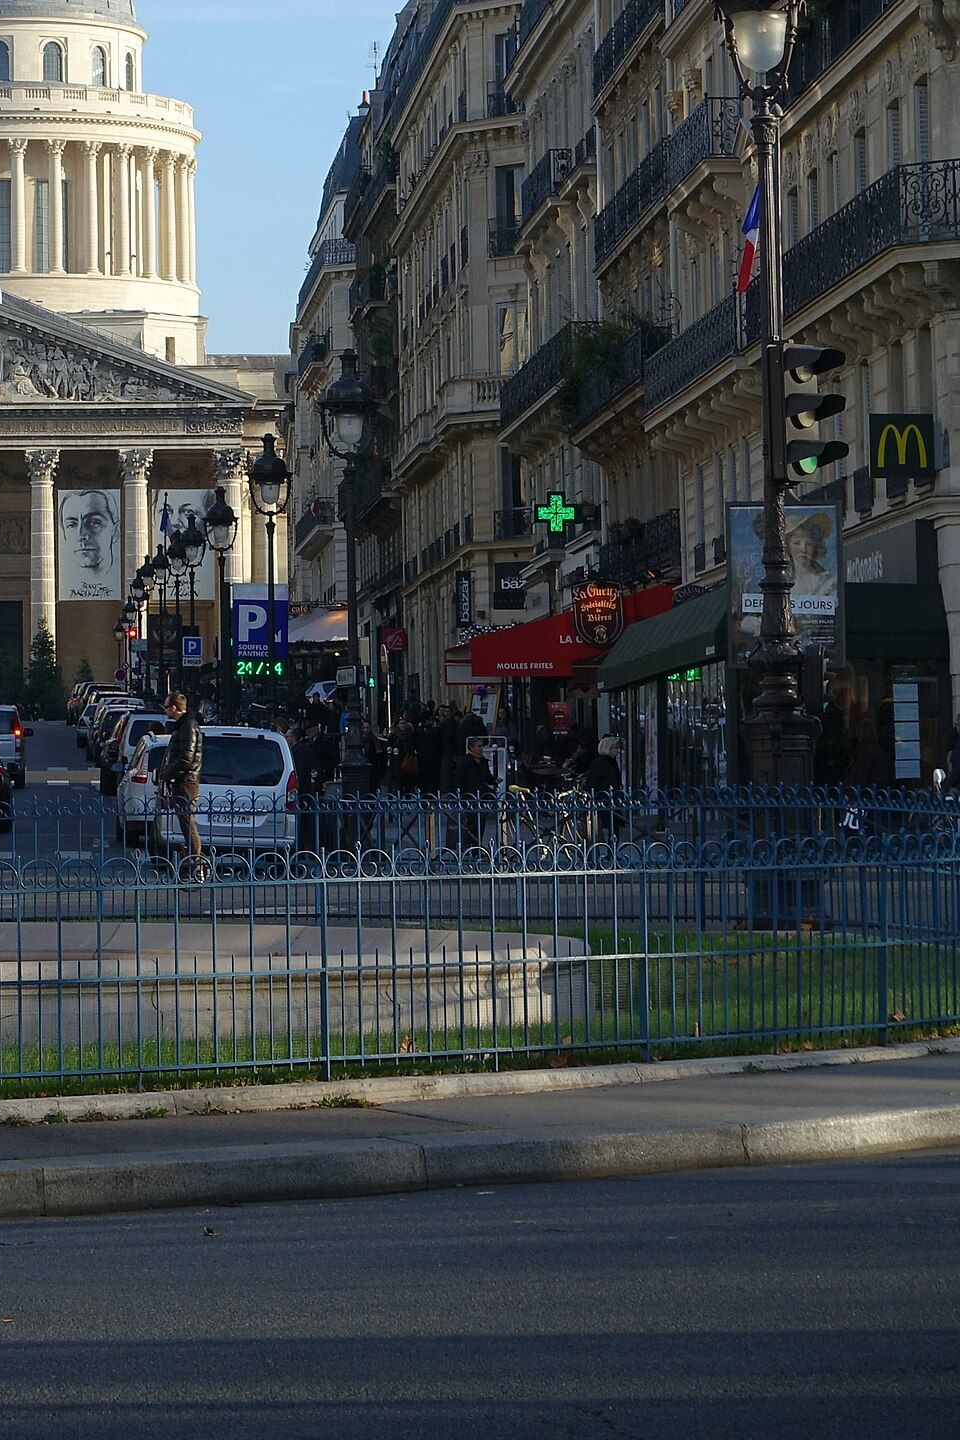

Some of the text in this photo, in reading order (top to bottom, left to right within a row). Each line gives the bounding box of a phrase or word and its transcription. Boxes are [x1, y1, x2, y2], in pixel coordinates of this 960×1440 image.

[460, 576, 470, 622] bazar
[291, 604, 309, 613] café
[798, 600, 833, 610] JOURS
[238, 604, 268, 642] P
[559, 634, 573, 644] LA
[188, 641, 197, 653] P
[236, 661, 283, 676] 24/4
[496, 662, 554, 670] MOULES FRITES
